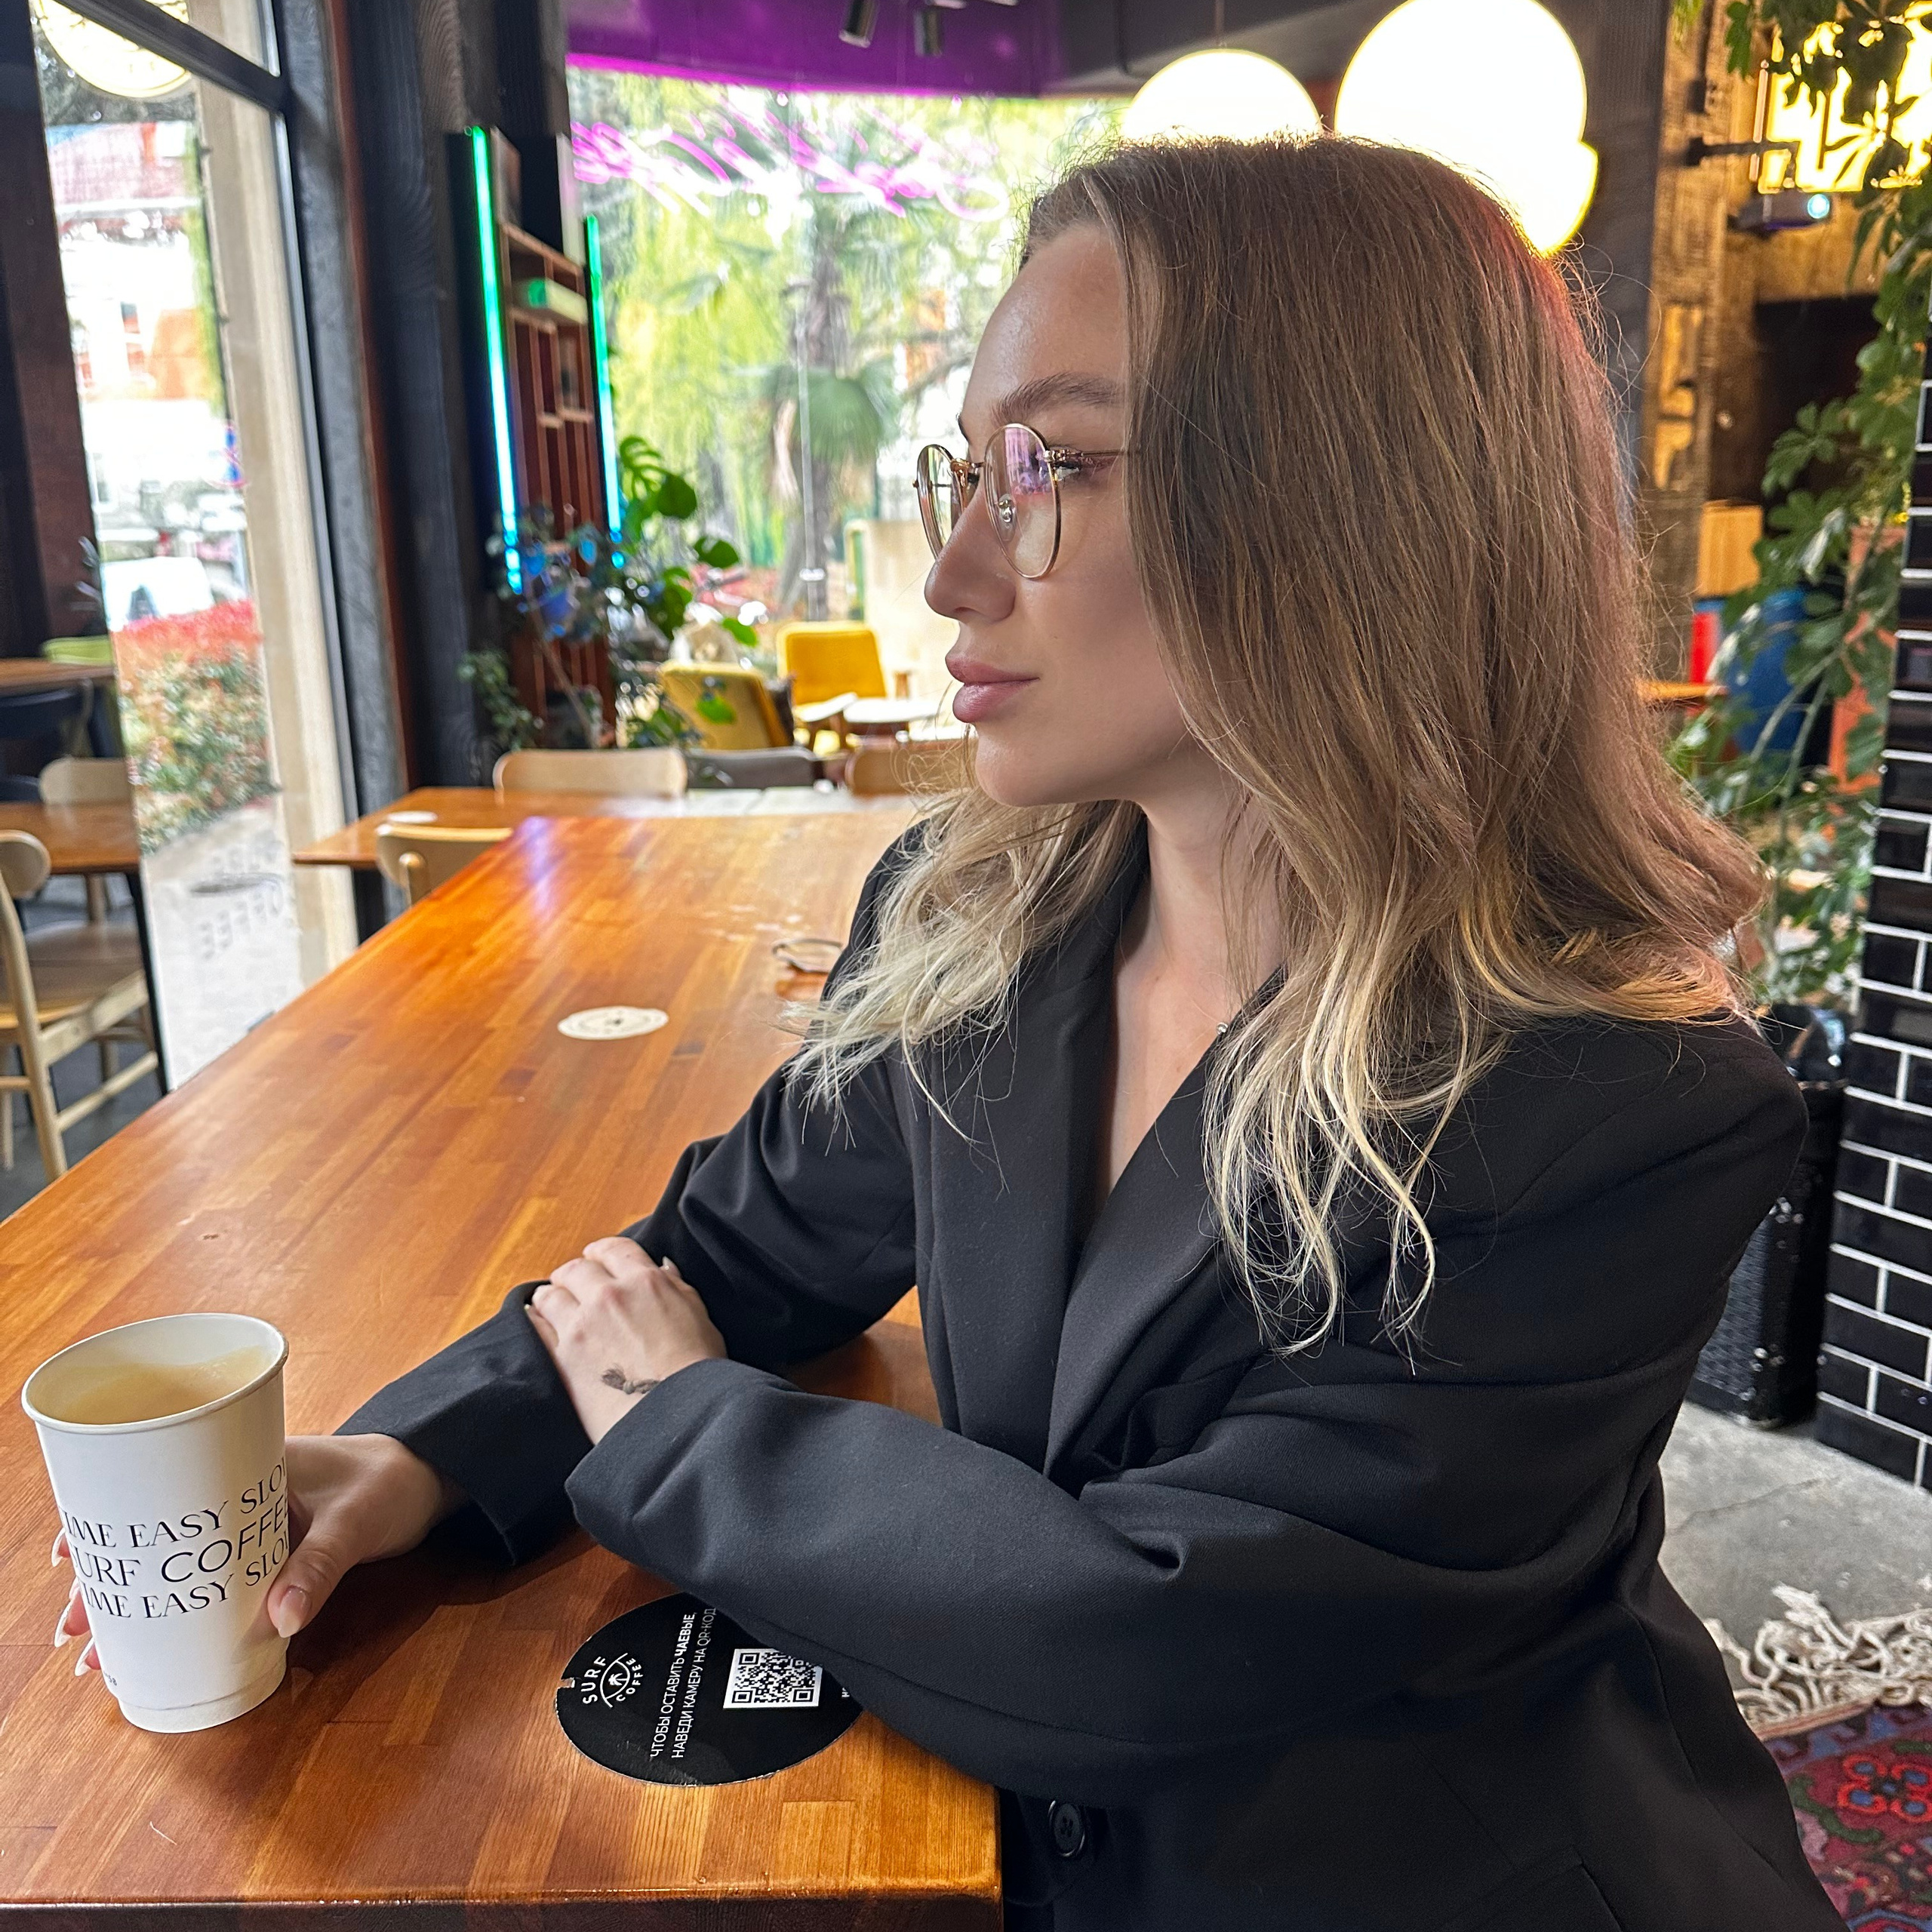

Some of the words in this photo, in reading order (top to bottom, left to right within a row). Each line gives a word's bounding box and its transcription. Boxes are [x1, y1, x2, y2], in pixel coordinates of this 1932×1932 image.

[127, 1500, 229, 1547] EASY
[140, 1574, 234, 1618] EASY
[675, 1612, 697, 1657] ЧАЕВЫЕ,
[697, 1607, 716, 1647] QR-КОД
[694, 1647, 707, 1663] НА
[581, 1657, 606, 1704] SURF
[616, 1658, 644, 1701] COFFEE
[660, 1657, 685, 1714] ОСТАВИТЬ
[683, 1665, 703, 1708] КАМЕРУ
[650, 1716, 671, 1757] ЧТОБЫ
[671, 1711, 694, 1758] НАВЕДИ
